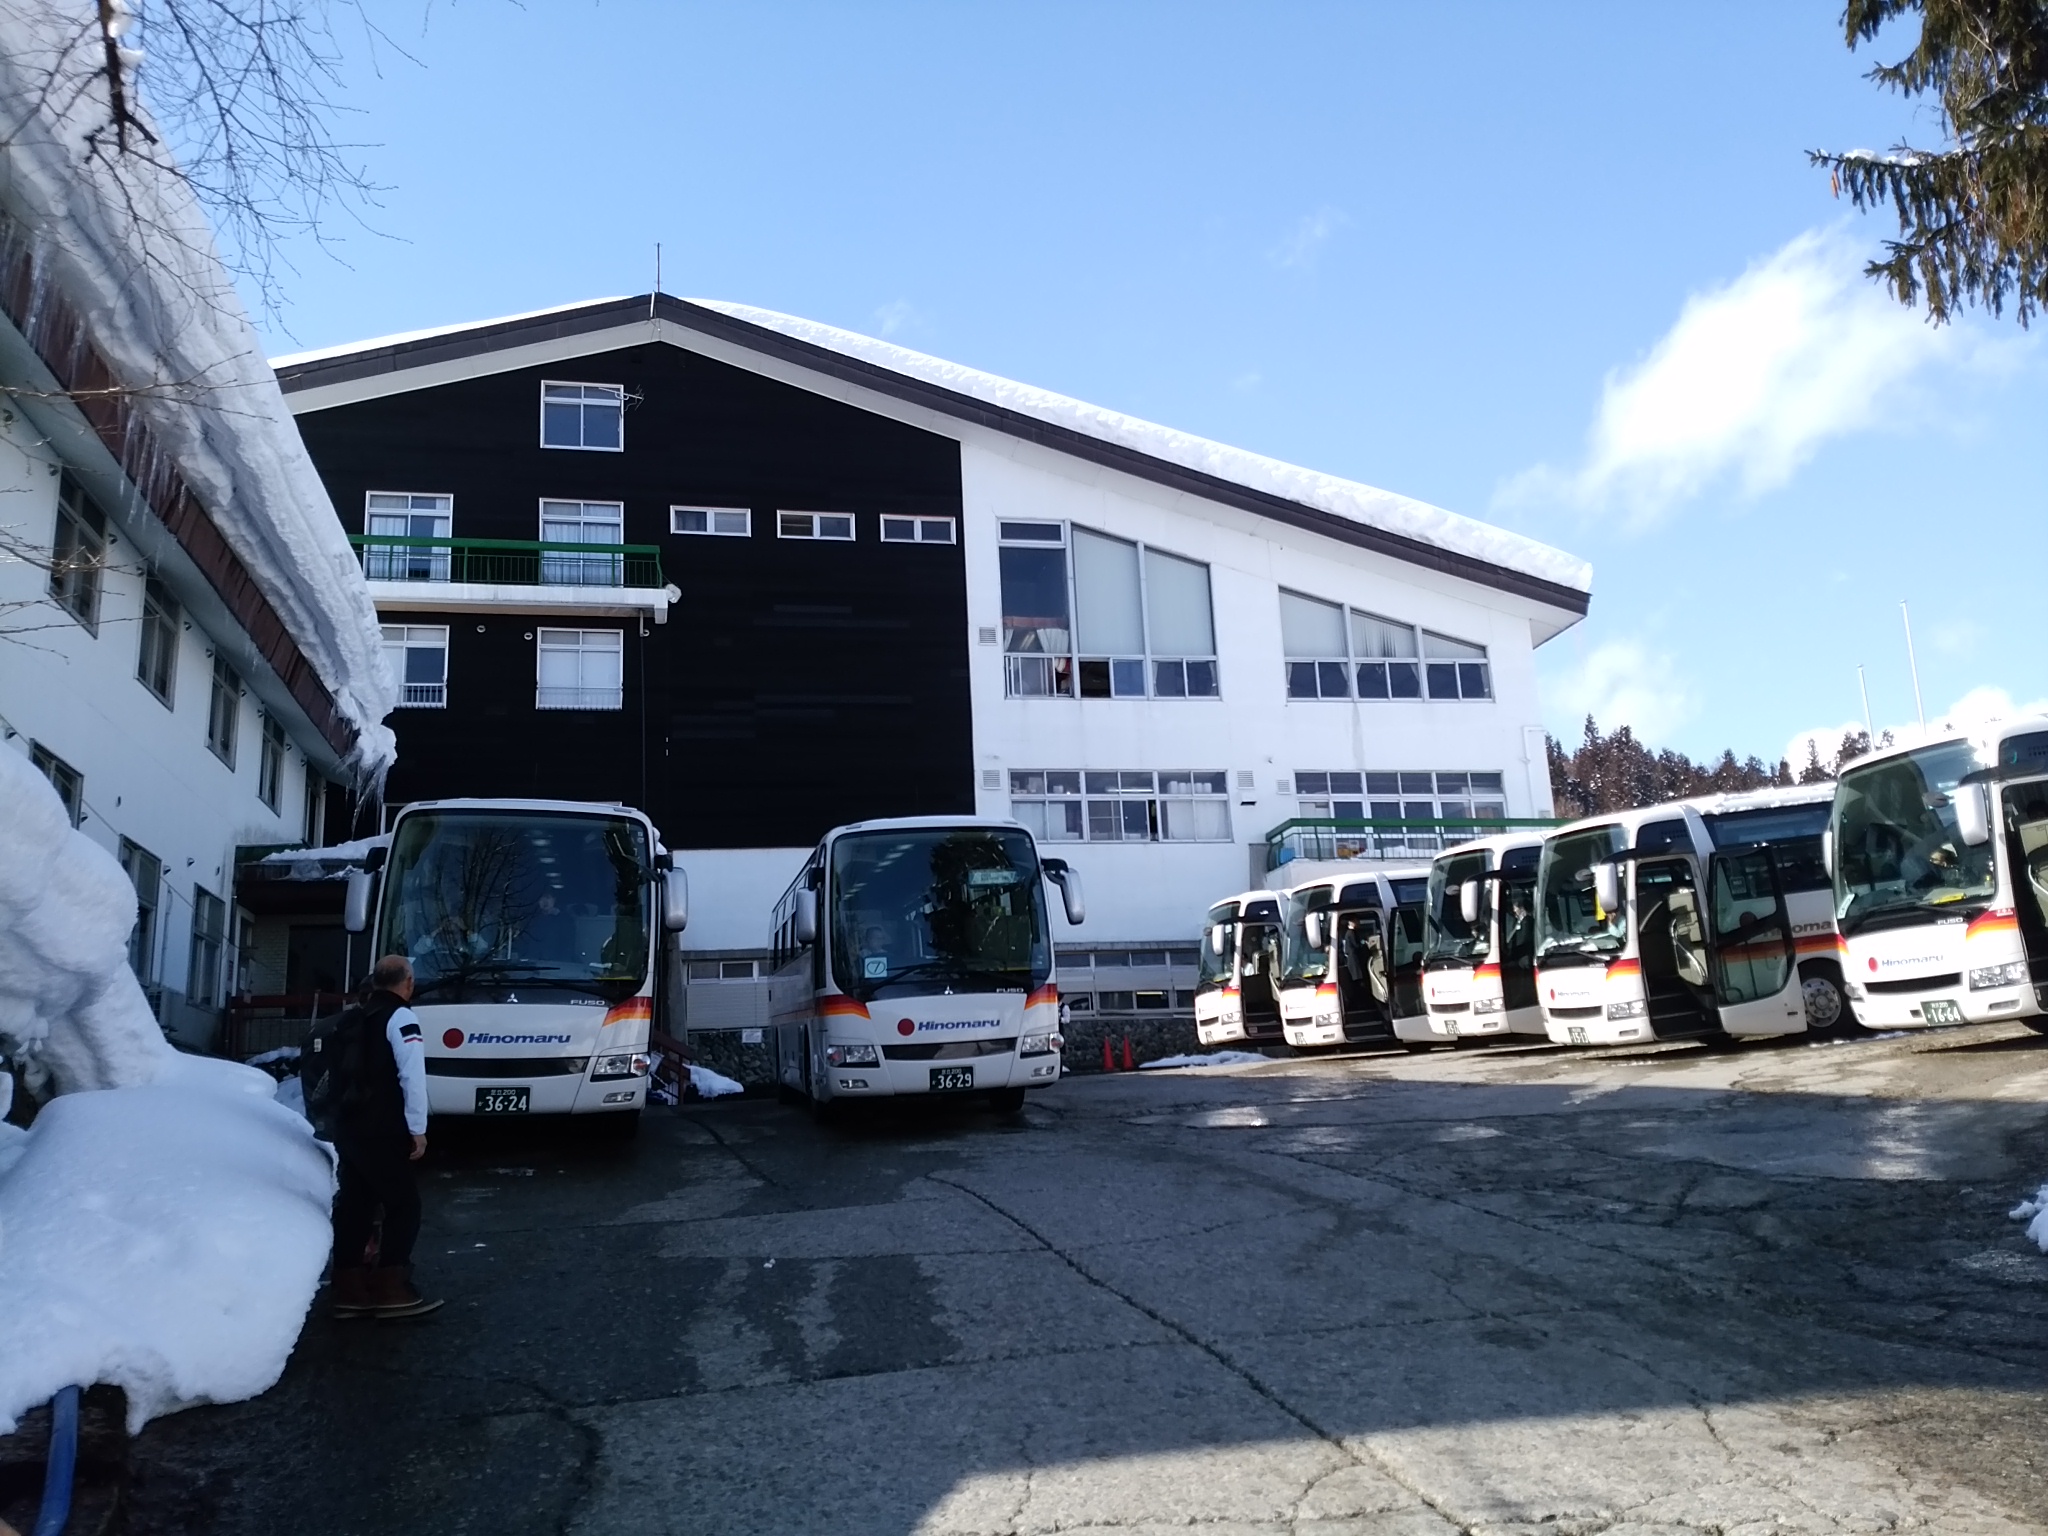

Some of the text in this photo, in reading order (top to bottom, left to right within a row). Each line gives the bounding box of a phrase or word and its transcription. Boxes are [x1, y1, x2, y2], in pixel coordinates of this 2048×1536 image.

[1937, 917, 1964, 926] FUSO
[1881, 954, 1944, 967] Hinomaru
[918, 1019, 1001, 1031] Hinomaru
[467, 1033, 571, 1044] Hinomaru
